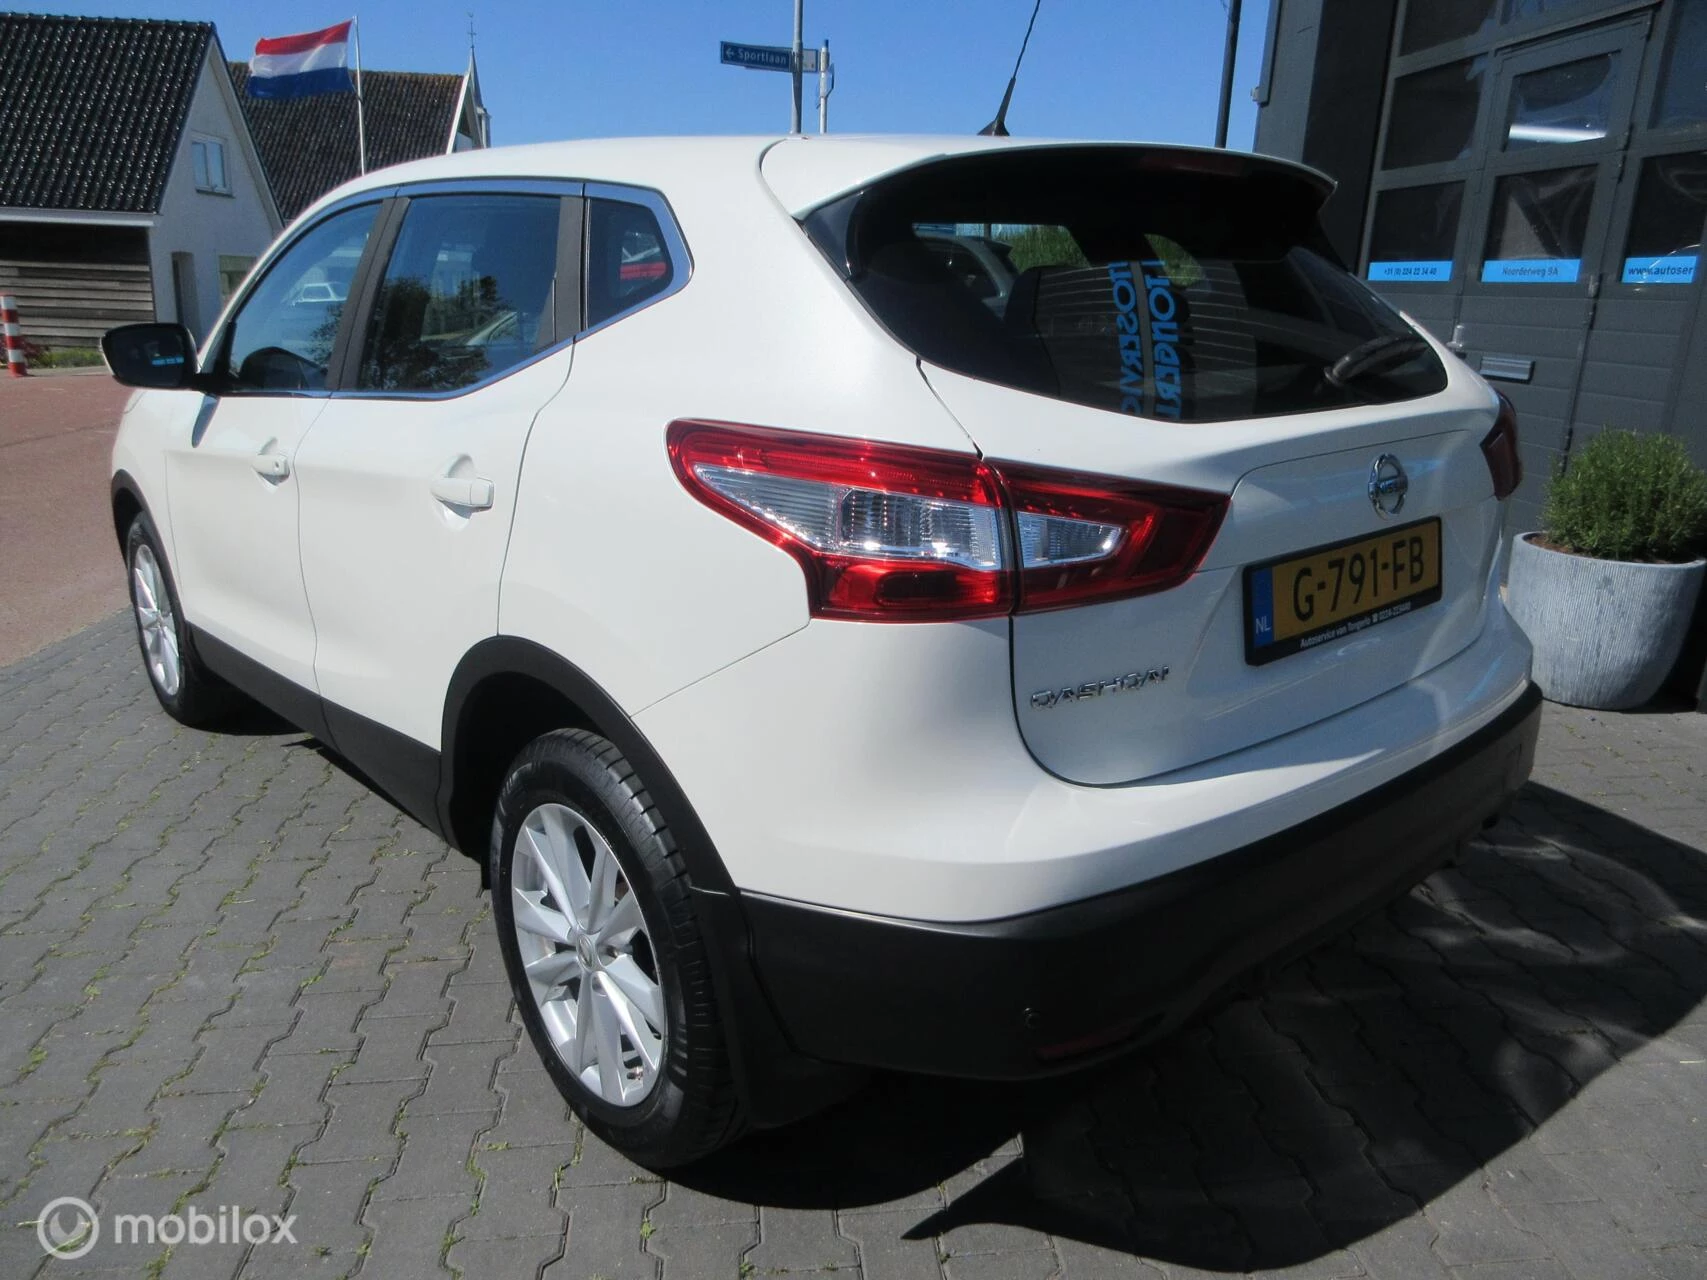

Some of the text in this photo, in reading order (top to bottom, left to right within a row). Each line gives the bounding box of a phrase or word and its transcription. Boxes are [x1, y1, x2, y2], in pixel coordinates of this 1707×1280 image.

[739, 49, 787, 65] Sportlaan
[1293, 536, 1425, 622] G-791-FB
[1255, 616, 1271, 635] NL
